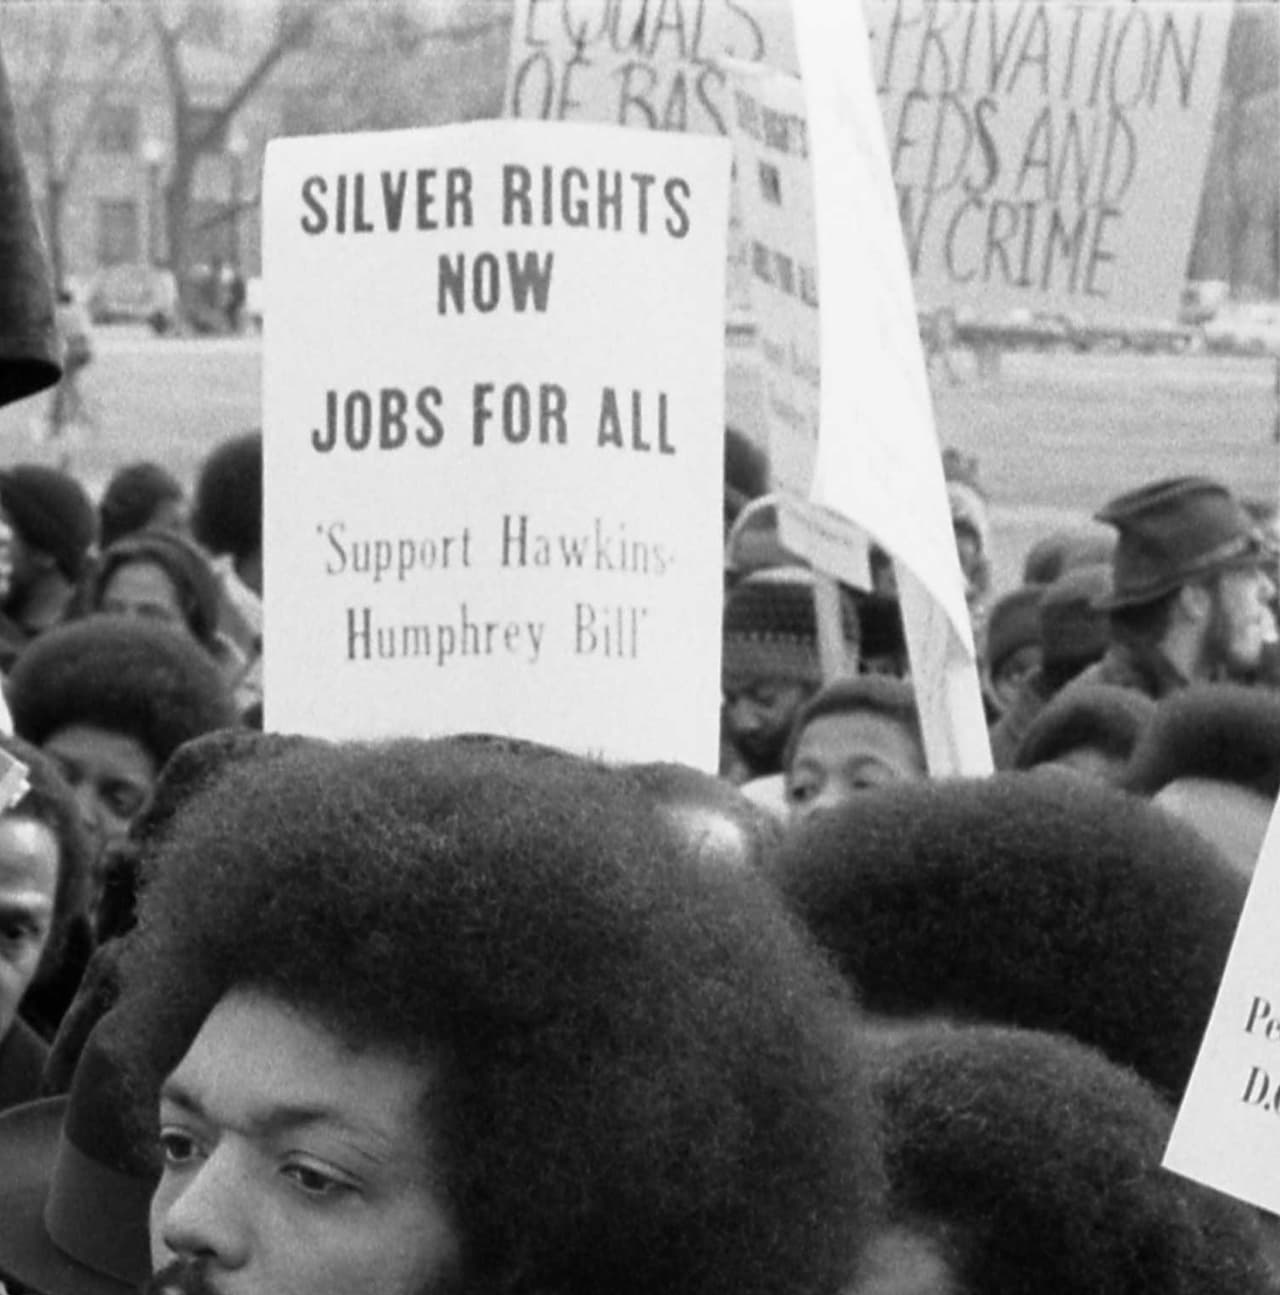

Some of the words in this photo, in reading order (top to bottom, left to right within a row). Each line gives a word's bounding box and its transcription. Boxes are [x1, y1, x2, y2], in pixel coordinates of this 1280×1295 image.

[876, 0, 1203, 109] PRIVATION
[613, 59, 728, 136] BAS
[891, 90, 1000, 196] EDS
[1015, 104, 1137, 208] AND
[301, 167, 474, 235] SILVER
[503, 164, 691, 238] RIGHTS
[438, 251, 554, 315] NOW
[944, 198, 1122, 298] CRIME
[312, 386, 444, 453] JOBS
[472, 382, 567, 446] FOR
[597, 386, 675, 454] ALL
[347, 602, 544, 667] Humphrey
